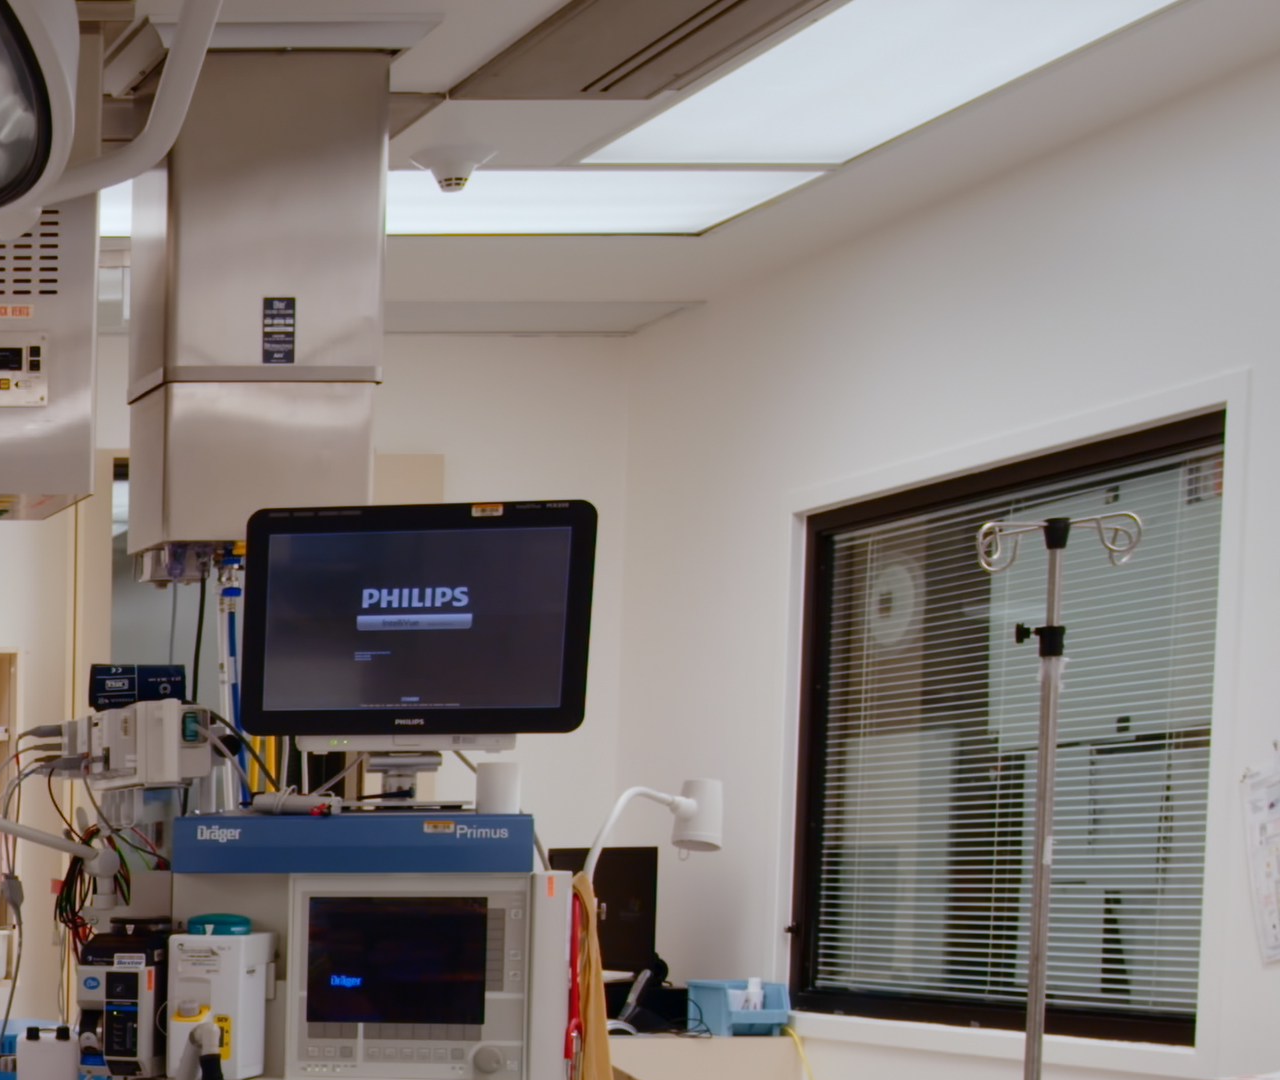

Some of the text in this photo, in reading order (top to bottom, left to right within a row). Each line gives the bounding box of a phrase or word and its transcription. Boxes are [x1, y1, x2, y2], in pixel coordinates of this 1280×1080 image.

[11, 305, 30, 317] VENTS
[361, 586, 469, 609] PHILIPS
[395, 718, 425, 726] PHILIPS
[197, 825, 241, 843] Dräger
[456, 825, 509, 839] Primus
[331, 974, 362, 988] Dräger
